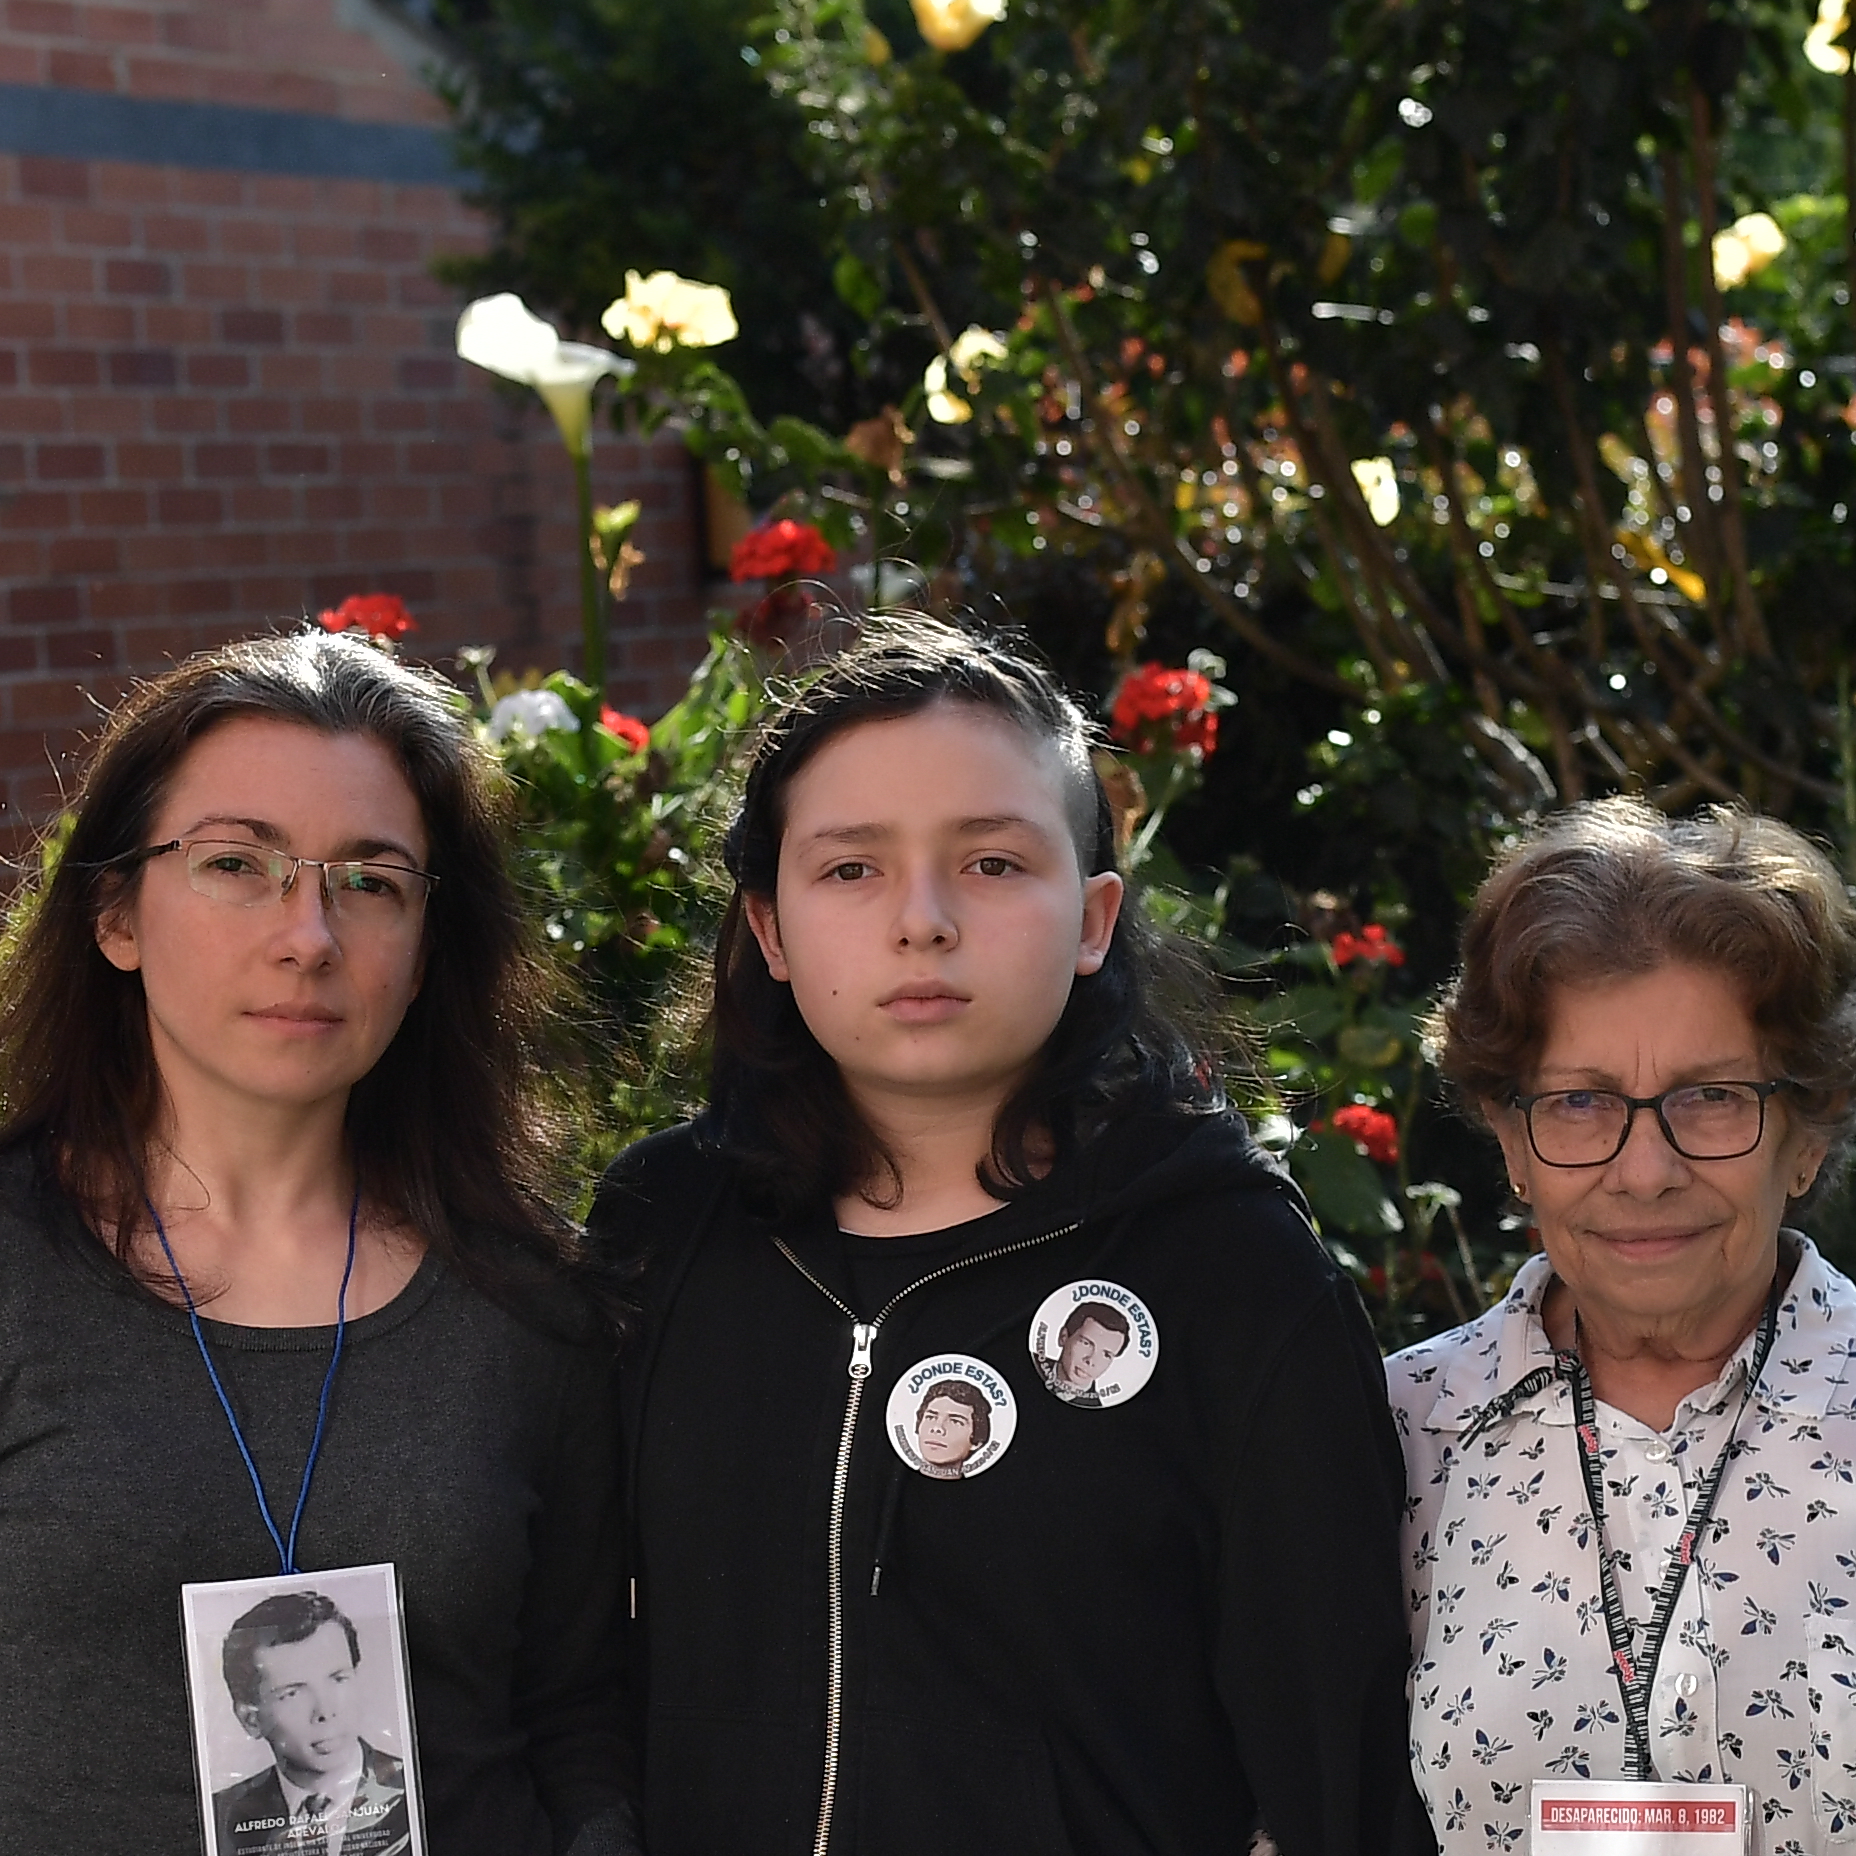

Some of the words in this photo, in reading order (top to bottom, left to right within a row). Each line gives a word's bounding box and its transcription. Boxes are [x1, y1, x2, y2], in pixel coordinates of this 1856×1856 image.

[1072, 1284, 1130, 1306] ¿DONDE
[1127, 1303, 1152, 1358] ESTAS?
[908, 1362, 963, 1394] ¿DONDE
[964, 1364, 1008, 1407] ESTAS?
[234, 1817, 286, 1833] ALFREDO
[1550, 1807, 1642, 1824] DESAPARECIDO:
[1645, 1808, 1675, 1824] MAR.
[1678, 1808, 1690, 1826] 8,
[1694, 1808, 1725, 1825] 1982
